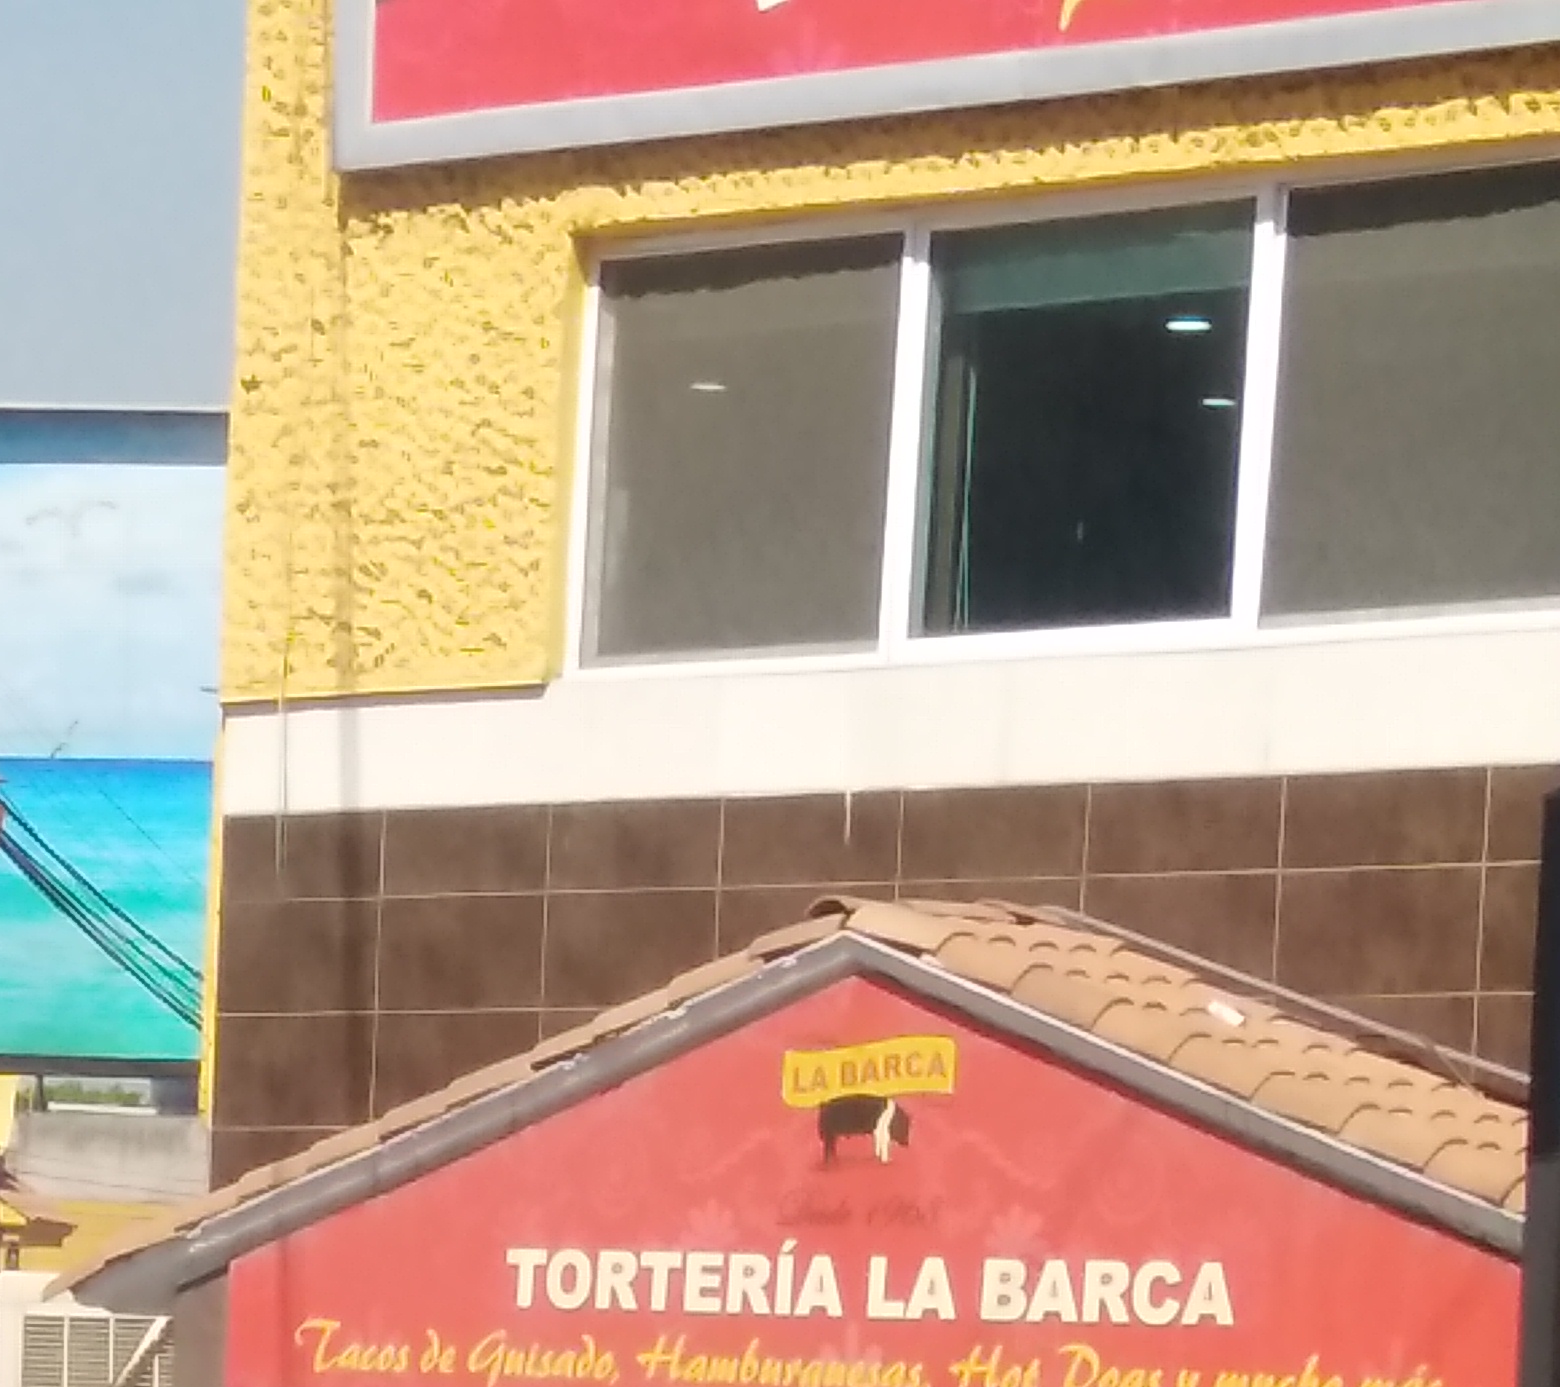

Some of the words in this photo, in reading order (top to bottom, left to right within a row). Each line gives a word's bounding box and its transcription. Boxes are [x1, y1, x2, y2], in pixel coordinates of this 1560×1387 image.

[792, 1066, 828, 1093] LA
[840, 1051, 947, 1087] BARCA
[505, 1238, 843, 1318] TORTERÍA
[866, 1255, 956, 1321] LA
[979, 1258, 1235, 1327] BARCA
[294, 1316, 410, 1374] Tacos
[419, 1328, 457, 1373] de
